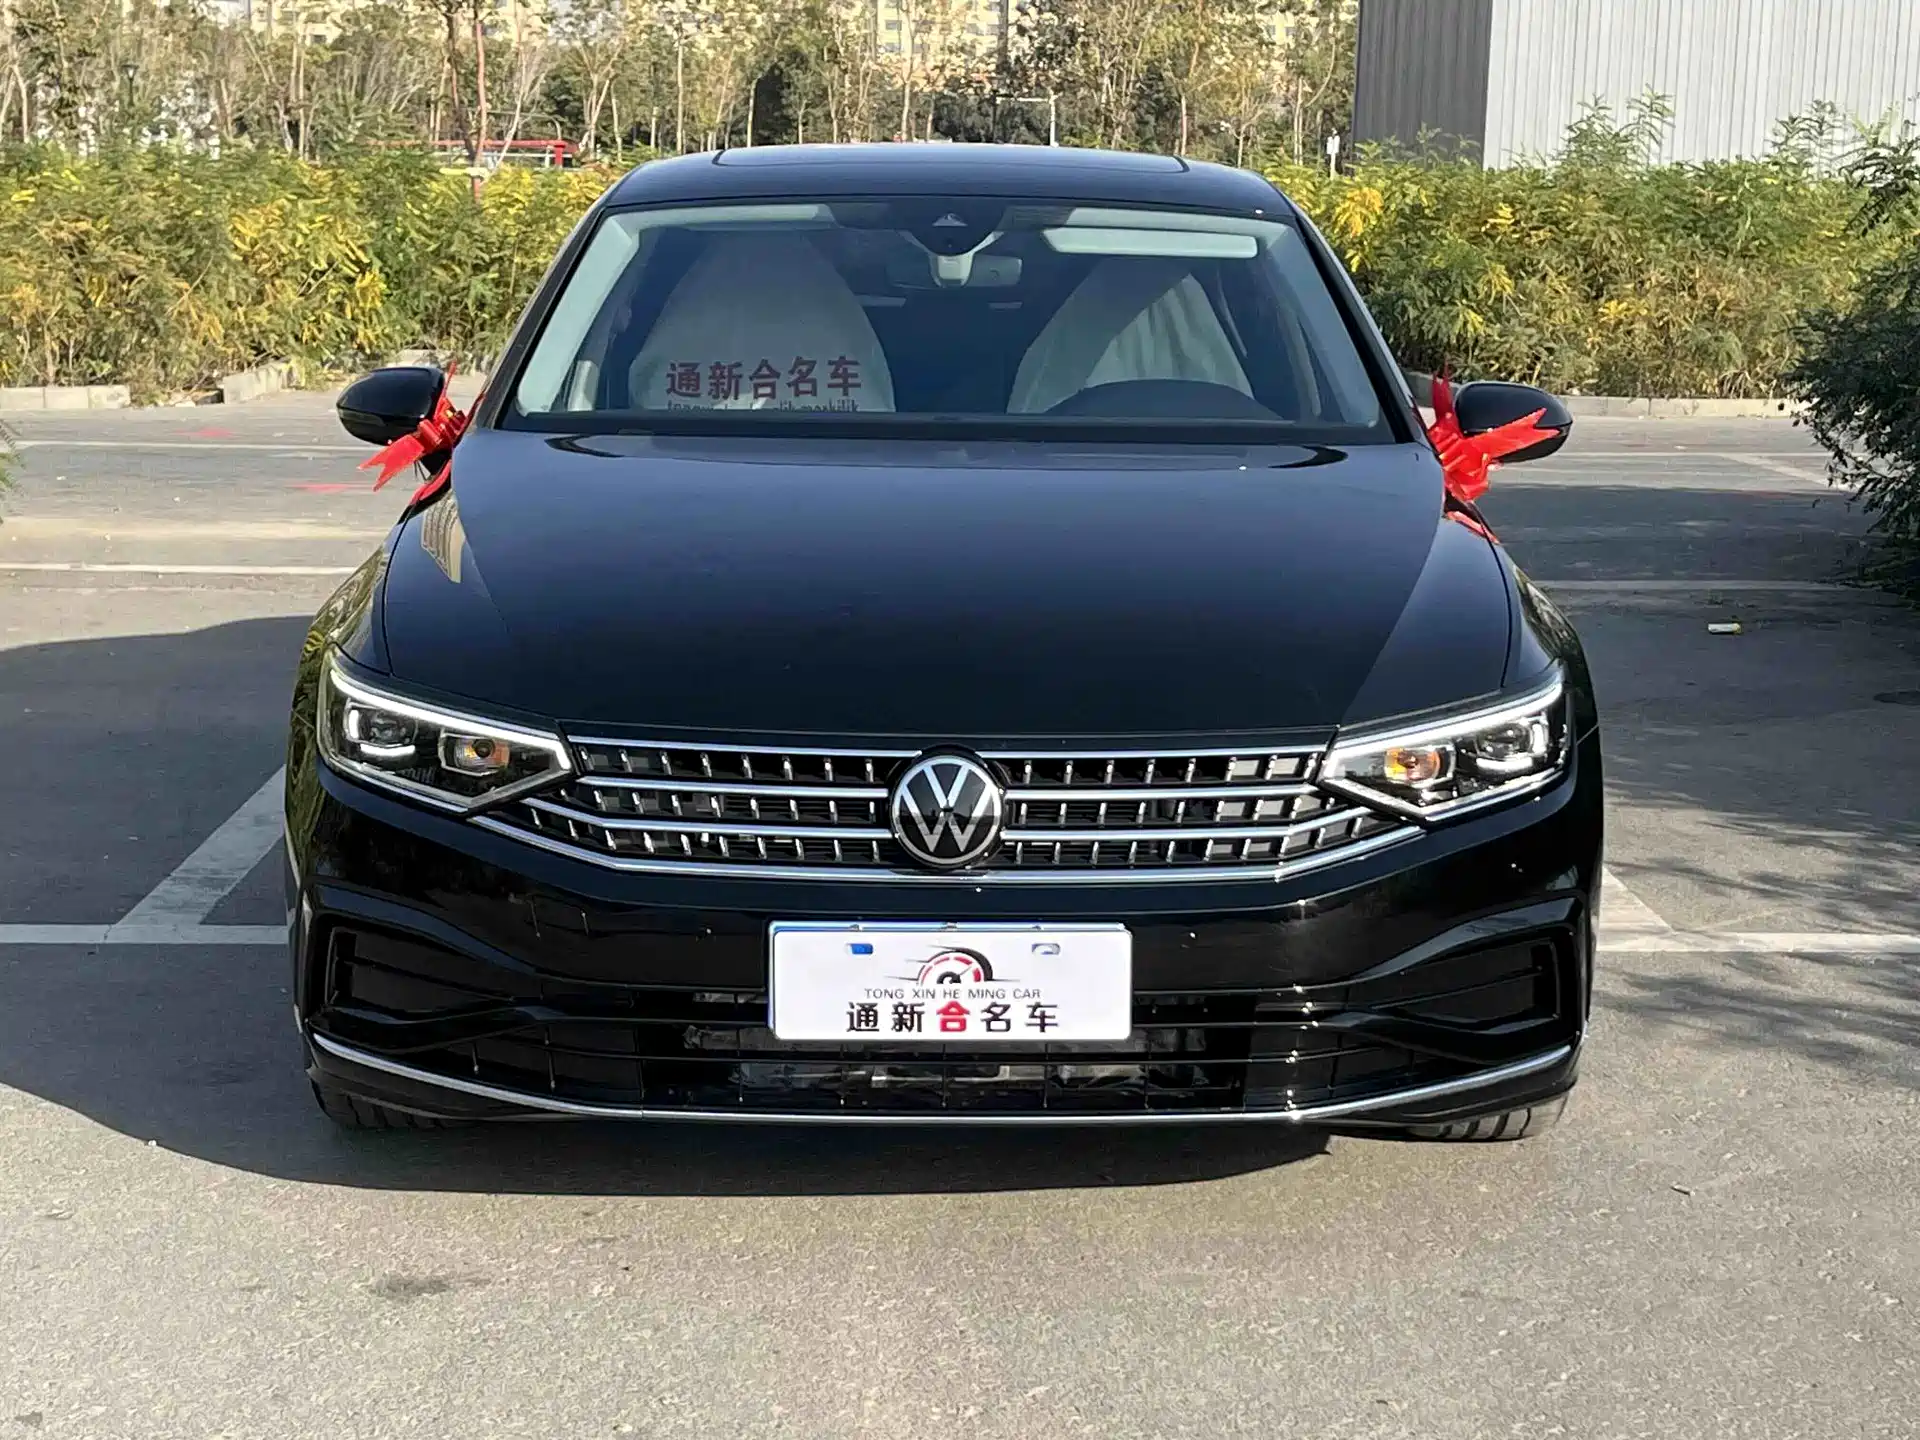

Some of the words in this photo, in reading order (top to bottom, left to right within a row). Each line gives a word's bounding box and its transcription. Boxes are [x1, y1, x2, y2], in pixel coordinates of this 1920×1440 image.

[666, 355, 862, 400] 通新合名车
[864, 988, 904, 999] TONG
[912, 988, 936, 999] XIN
[943, 988, 960, 999] HE
[968, 988, 1006, 999] MING
[1013, 988, 1041, 999] CAR
[846, 1001, 1059, 1032] 通新合名车
